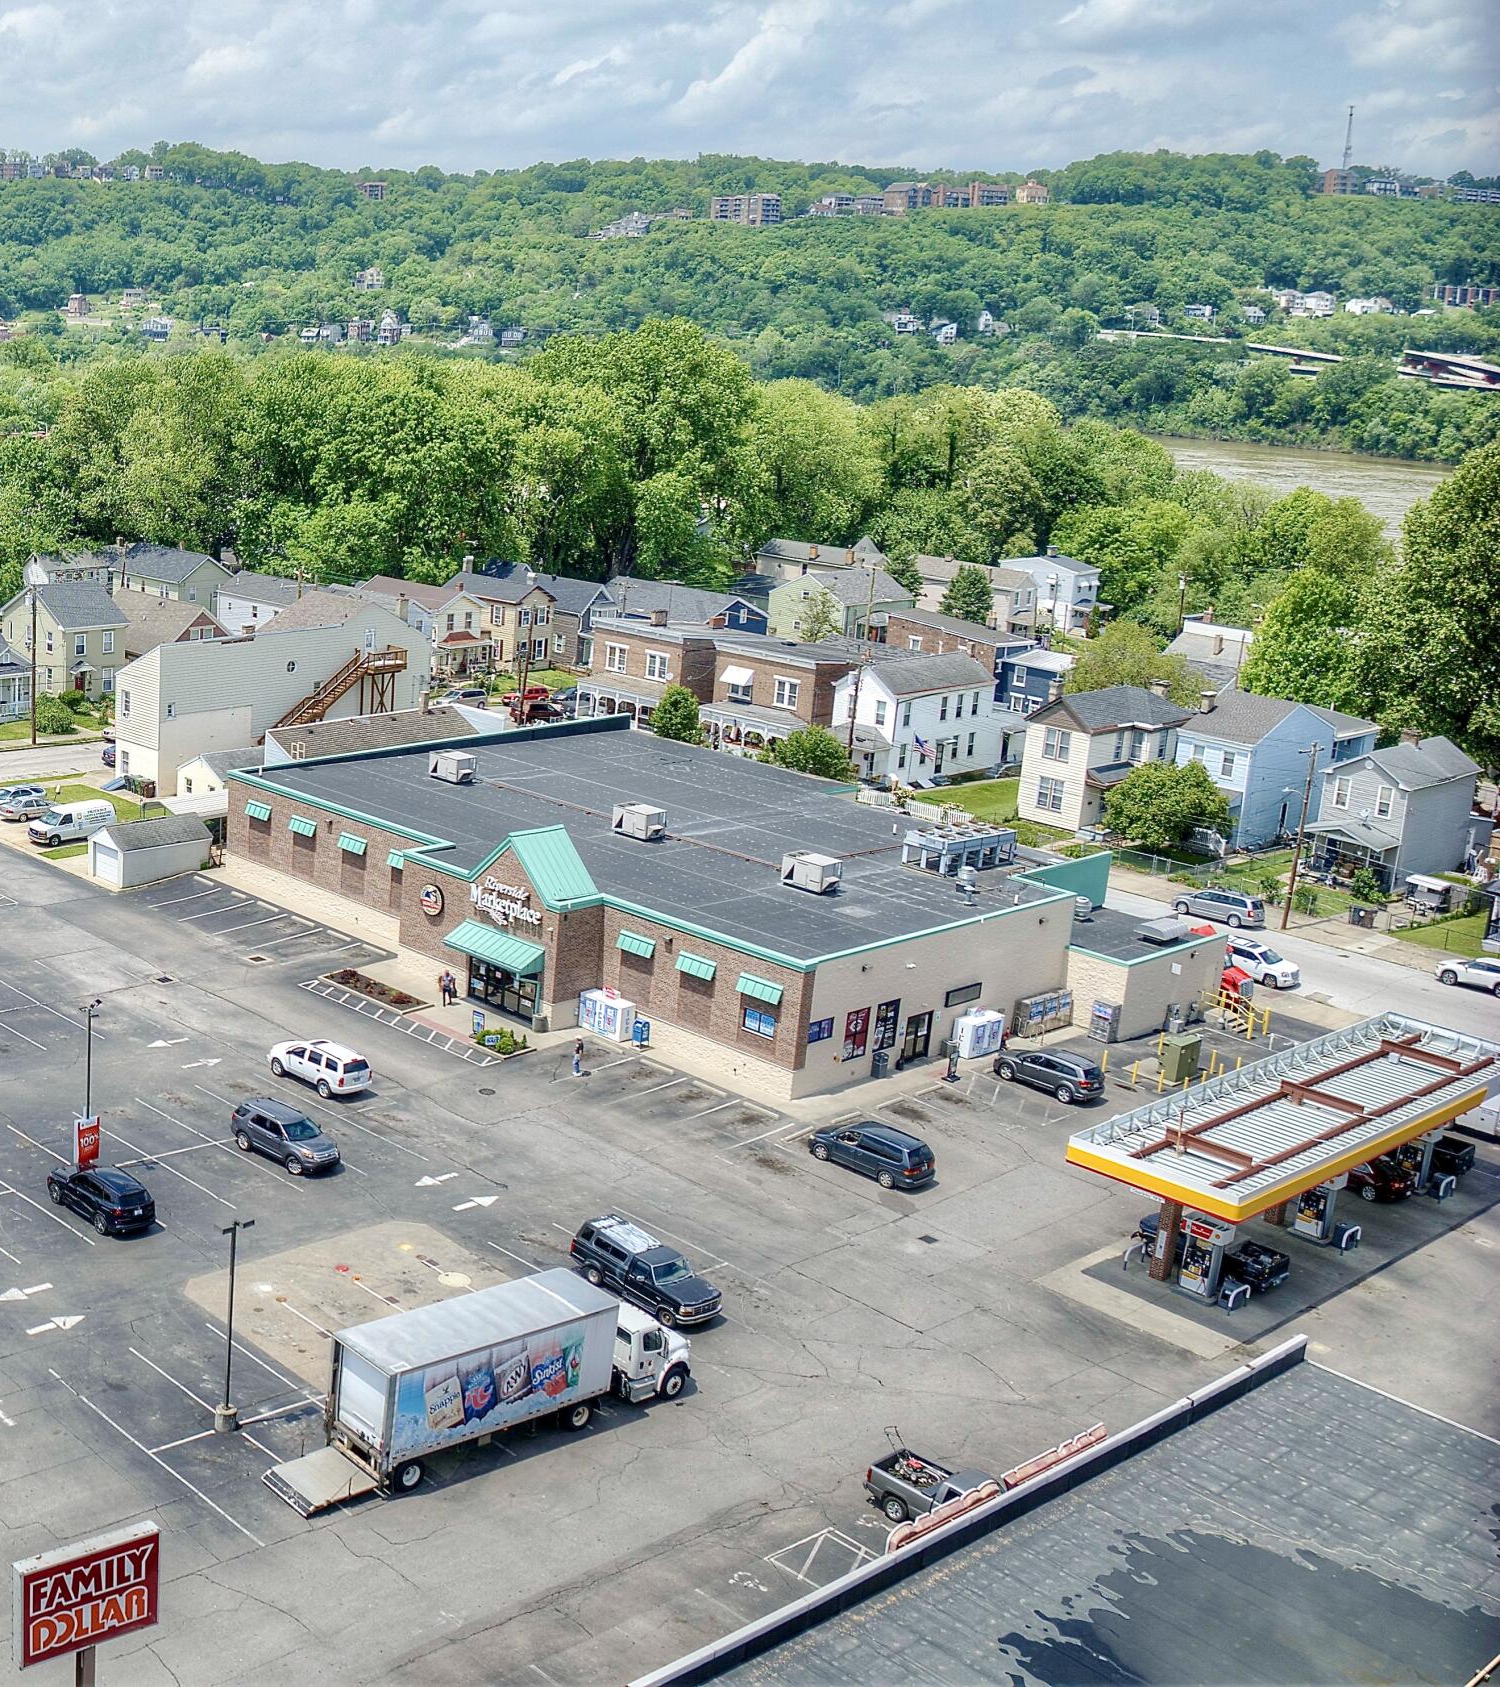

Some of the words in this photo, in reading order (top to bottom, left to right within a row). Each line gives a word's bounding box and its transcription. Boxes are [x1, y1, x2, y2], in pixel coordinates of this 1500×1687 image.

[484, 875, 530, 900] Riverside
[470, 882, 542, 925] Marketplace
[505, 1364, 525, 1393] A&W
[532, 1357, 563, 1385] Sunkist
[429, 1391, 461, 1415] Snapple
[29, 1543, 154, 1617] FAMILY
[29, 1585, 148, 1657] DOLLAR
